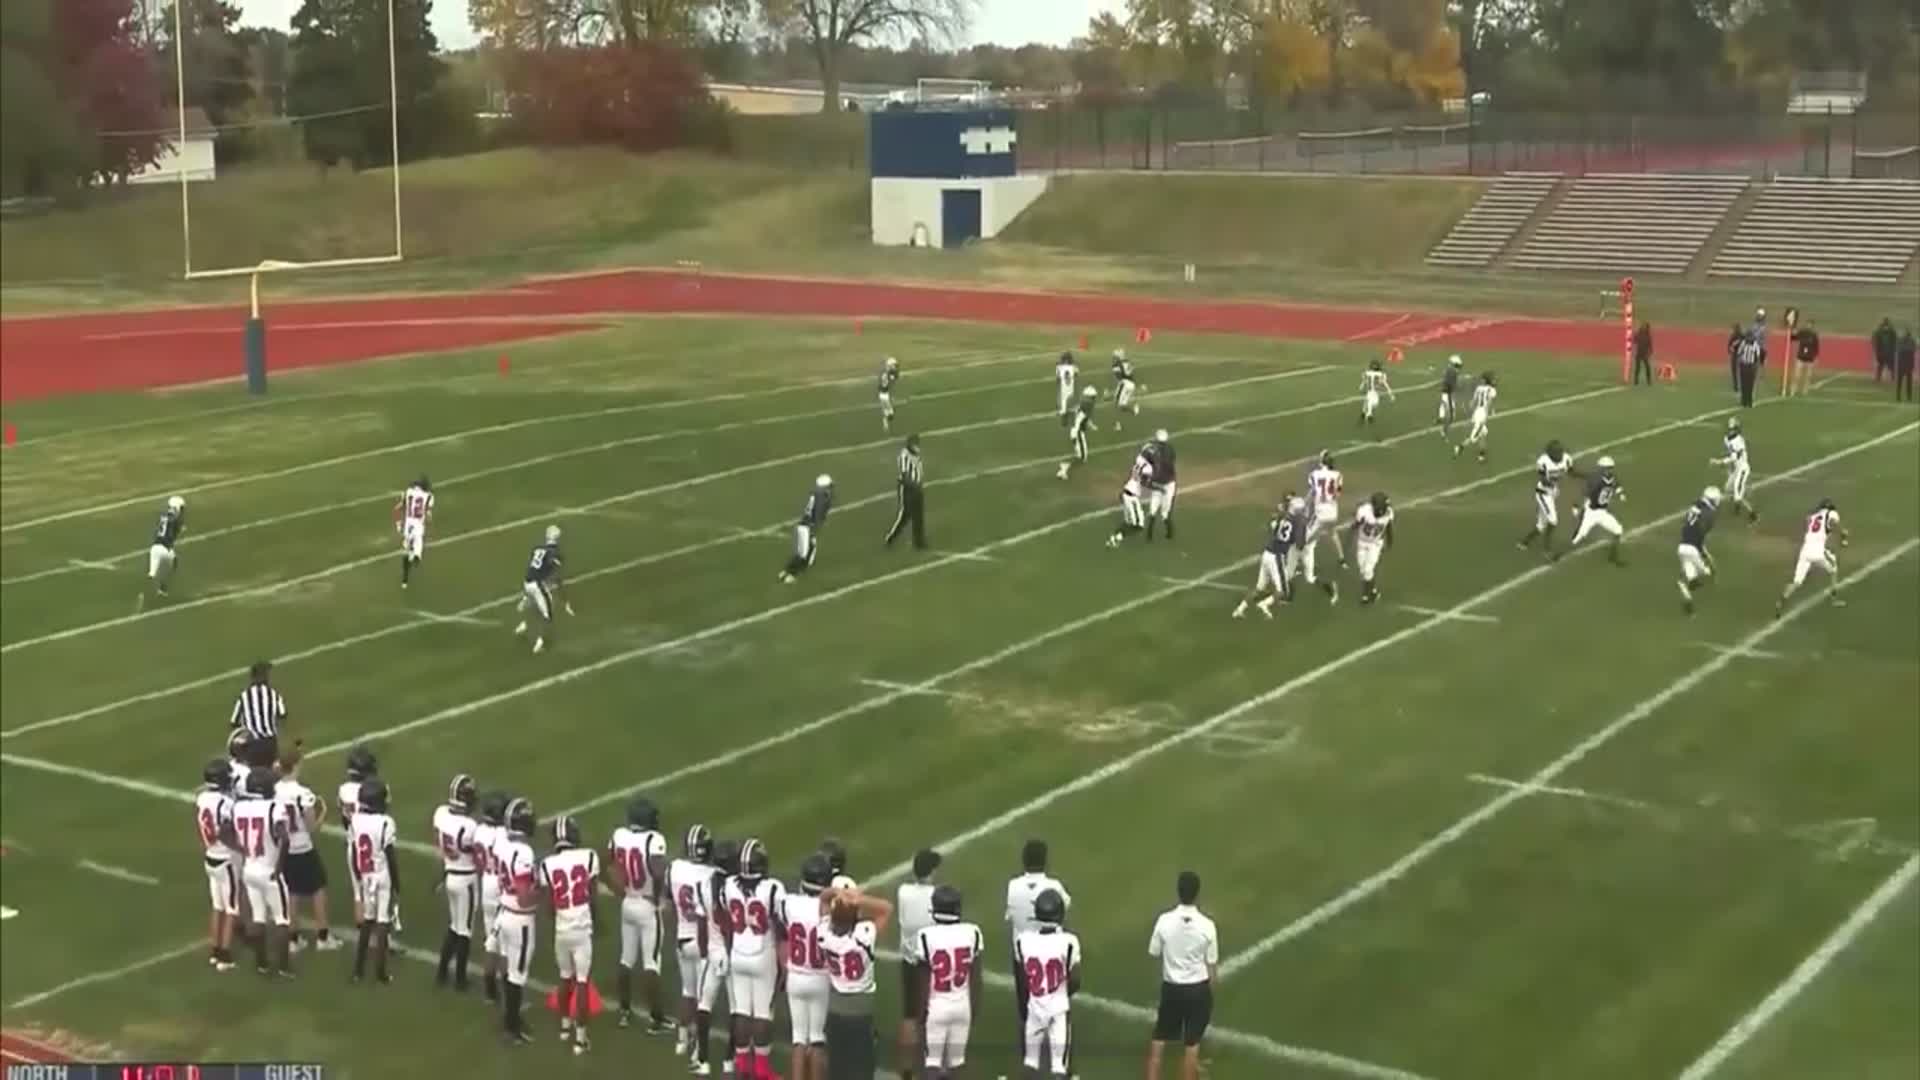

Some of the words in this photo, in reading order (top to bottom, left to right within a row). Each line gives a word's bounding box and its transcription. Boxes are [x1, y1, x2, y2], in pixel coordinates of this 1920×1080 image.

[407, 495, 424, 520] 12
[236, 816, 265, 857] 77
[551, 864, 591, 909] 22
[931, 946, 972, 993] 25
[1025, 957, 1067, 997] 20
